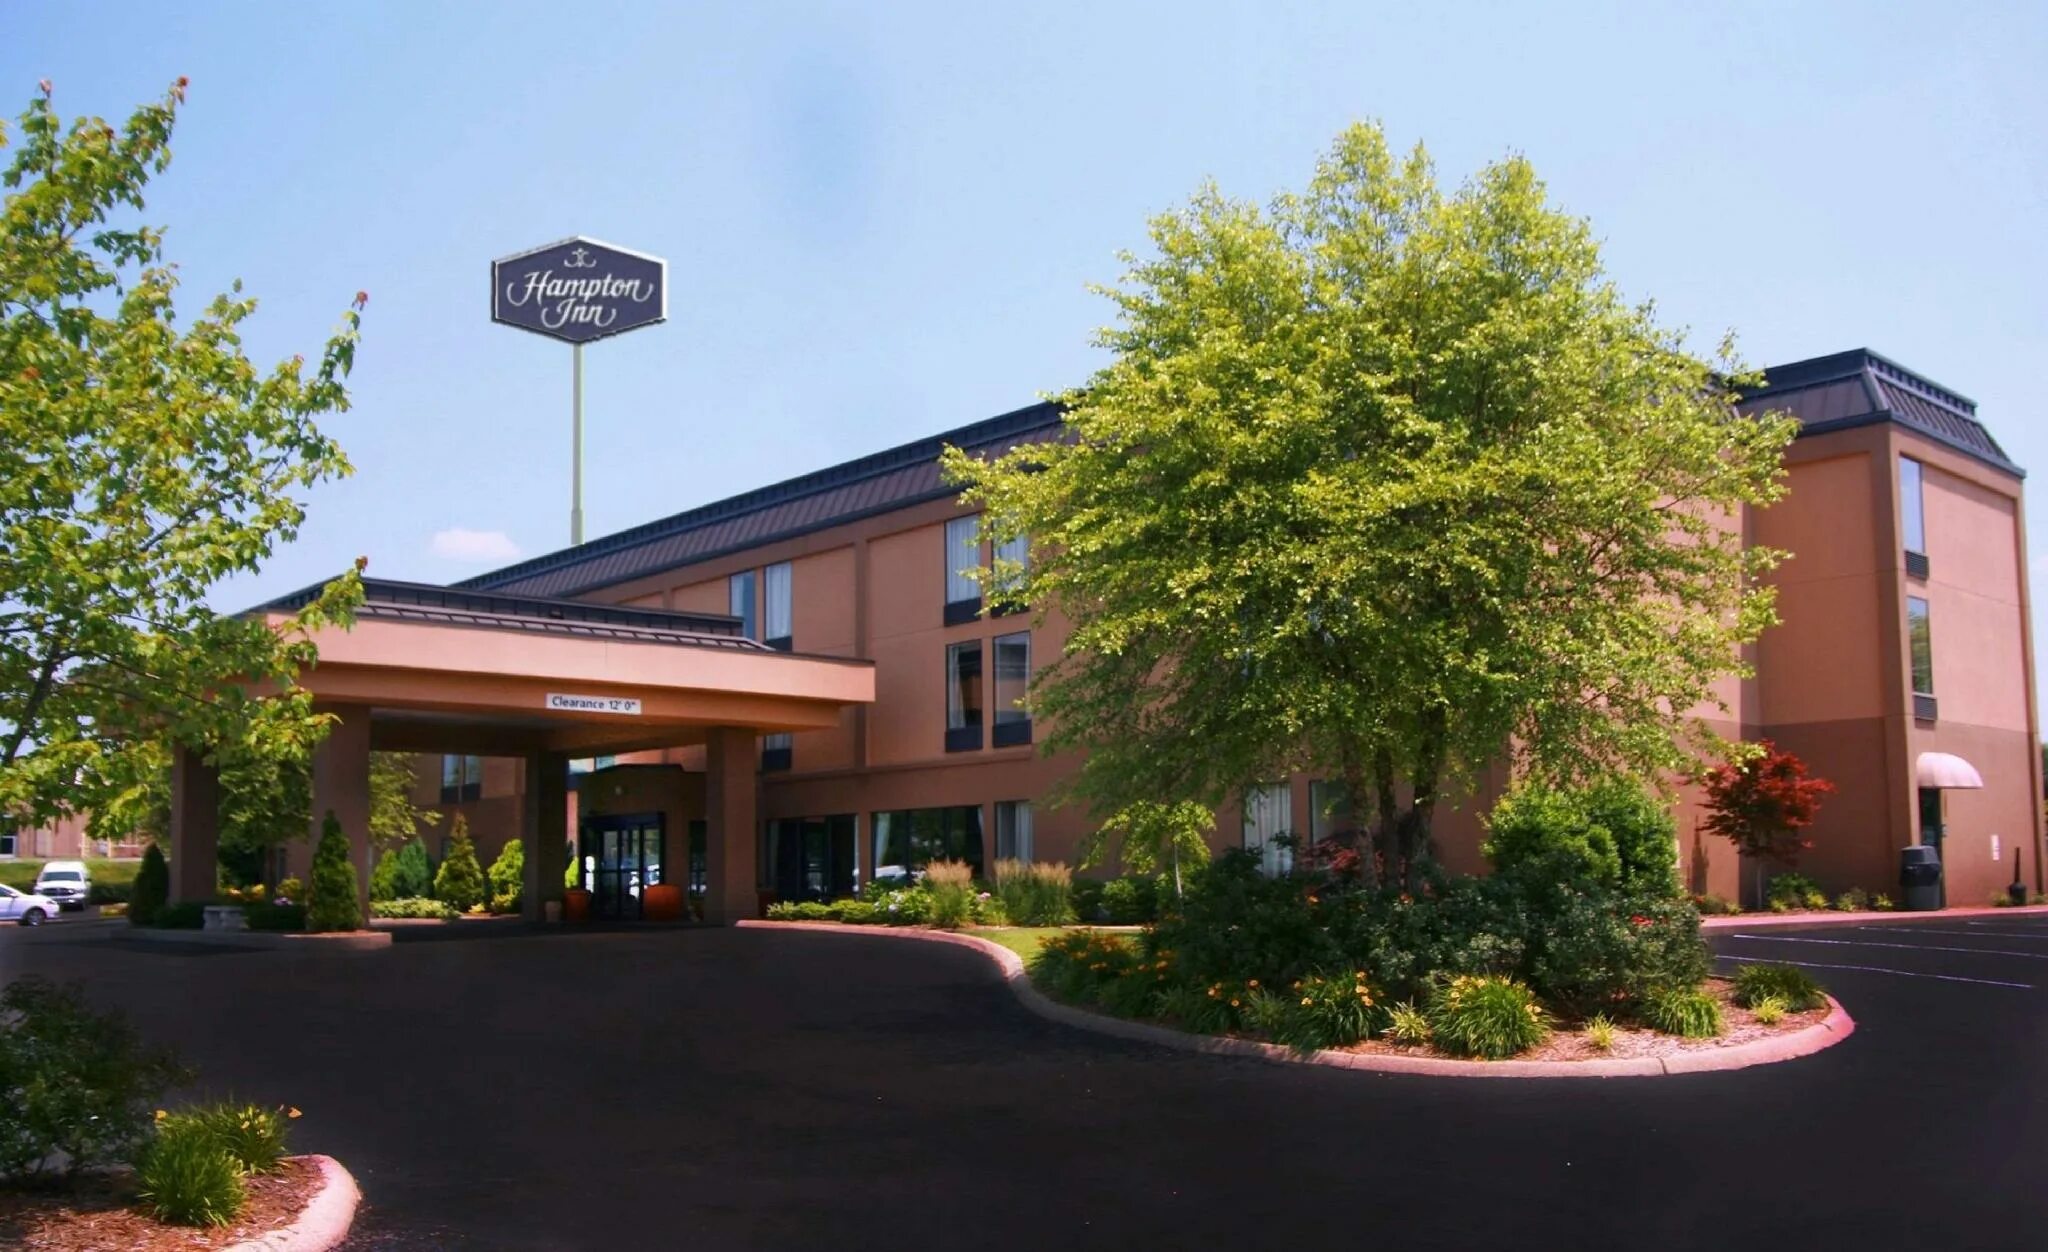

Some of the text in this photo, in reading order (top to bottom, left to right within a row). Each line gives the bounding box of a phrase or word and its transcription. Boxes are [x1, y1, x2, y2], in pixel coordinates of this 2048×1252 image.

[507, 270, 654, 306] Hampton
[541, 298, 616, 328] Inn
[551, 695, 605, 709] Clearance
